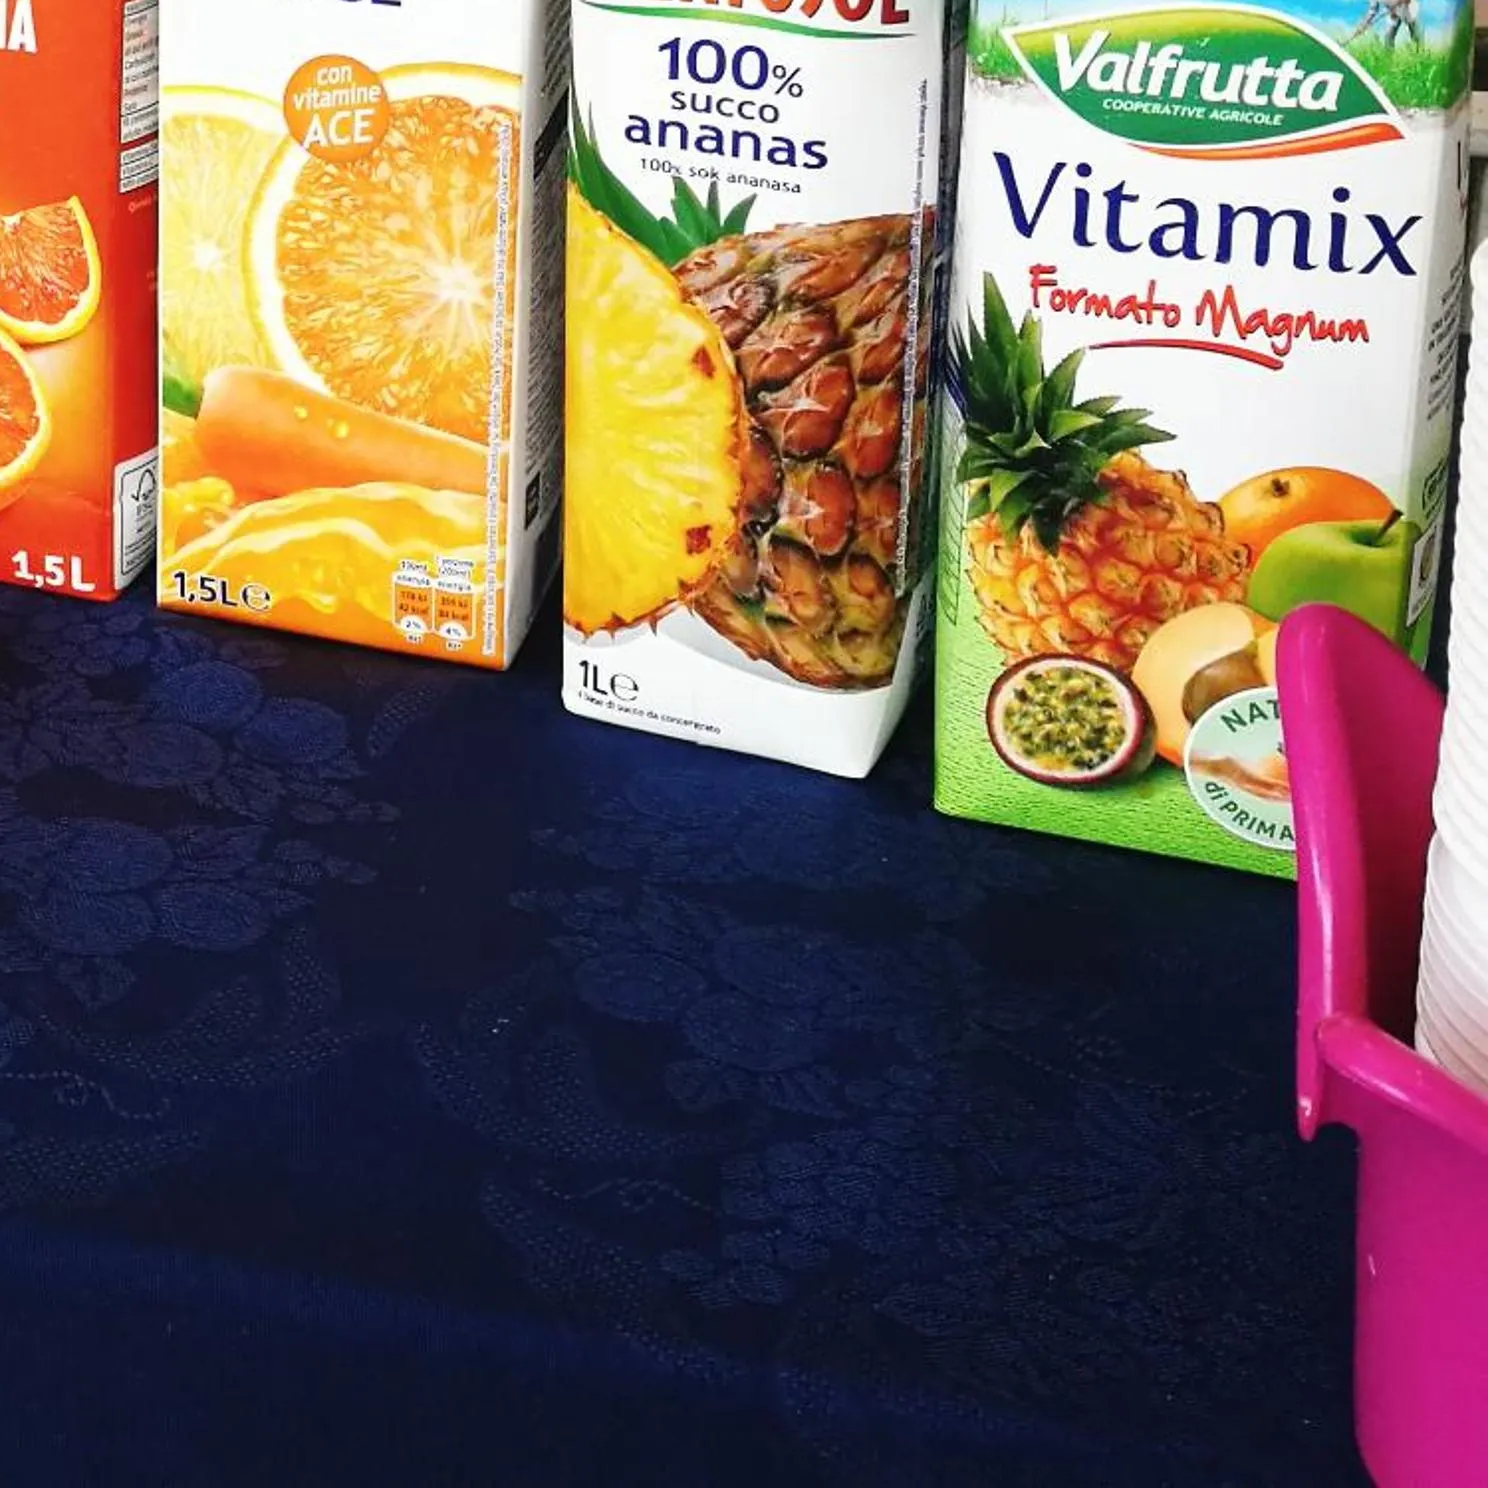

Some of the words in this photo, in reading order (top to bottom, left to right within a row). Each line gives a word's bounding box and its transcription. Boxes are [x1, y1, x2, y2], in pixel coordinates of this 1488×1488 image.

[316, 65, 353, 87] con
[658, 37, 803, 98] 100%
[1053, 29, 1344, 112] Valfrutta
[292, 83, 382, 111] vitamine
[671, 90, 780, 124] succo
[1102, 98, 1205, 120] COOPERATIVE
[1209, 108, 1284, 126] AGRICOLE
[303, 109, 376, 149] ACE
[624, 114, 829, 170] ananas
[688, 165, 720, 181] sok
[727, 172, 802, 194] ananasa
[993, 151, 1423, 276] Vitamix
[1028, 263, 1181, 327] Formato
[1196, 284, 1369, 356] Magnum
[12, 550, 95, 592] 1,5L
[173, 571, 238, 607] 1,5L
[579, 660, 608, 695] 1L
[1220, 699, 1279, 733] NAT
[1205, 781, 1230, 802] di
